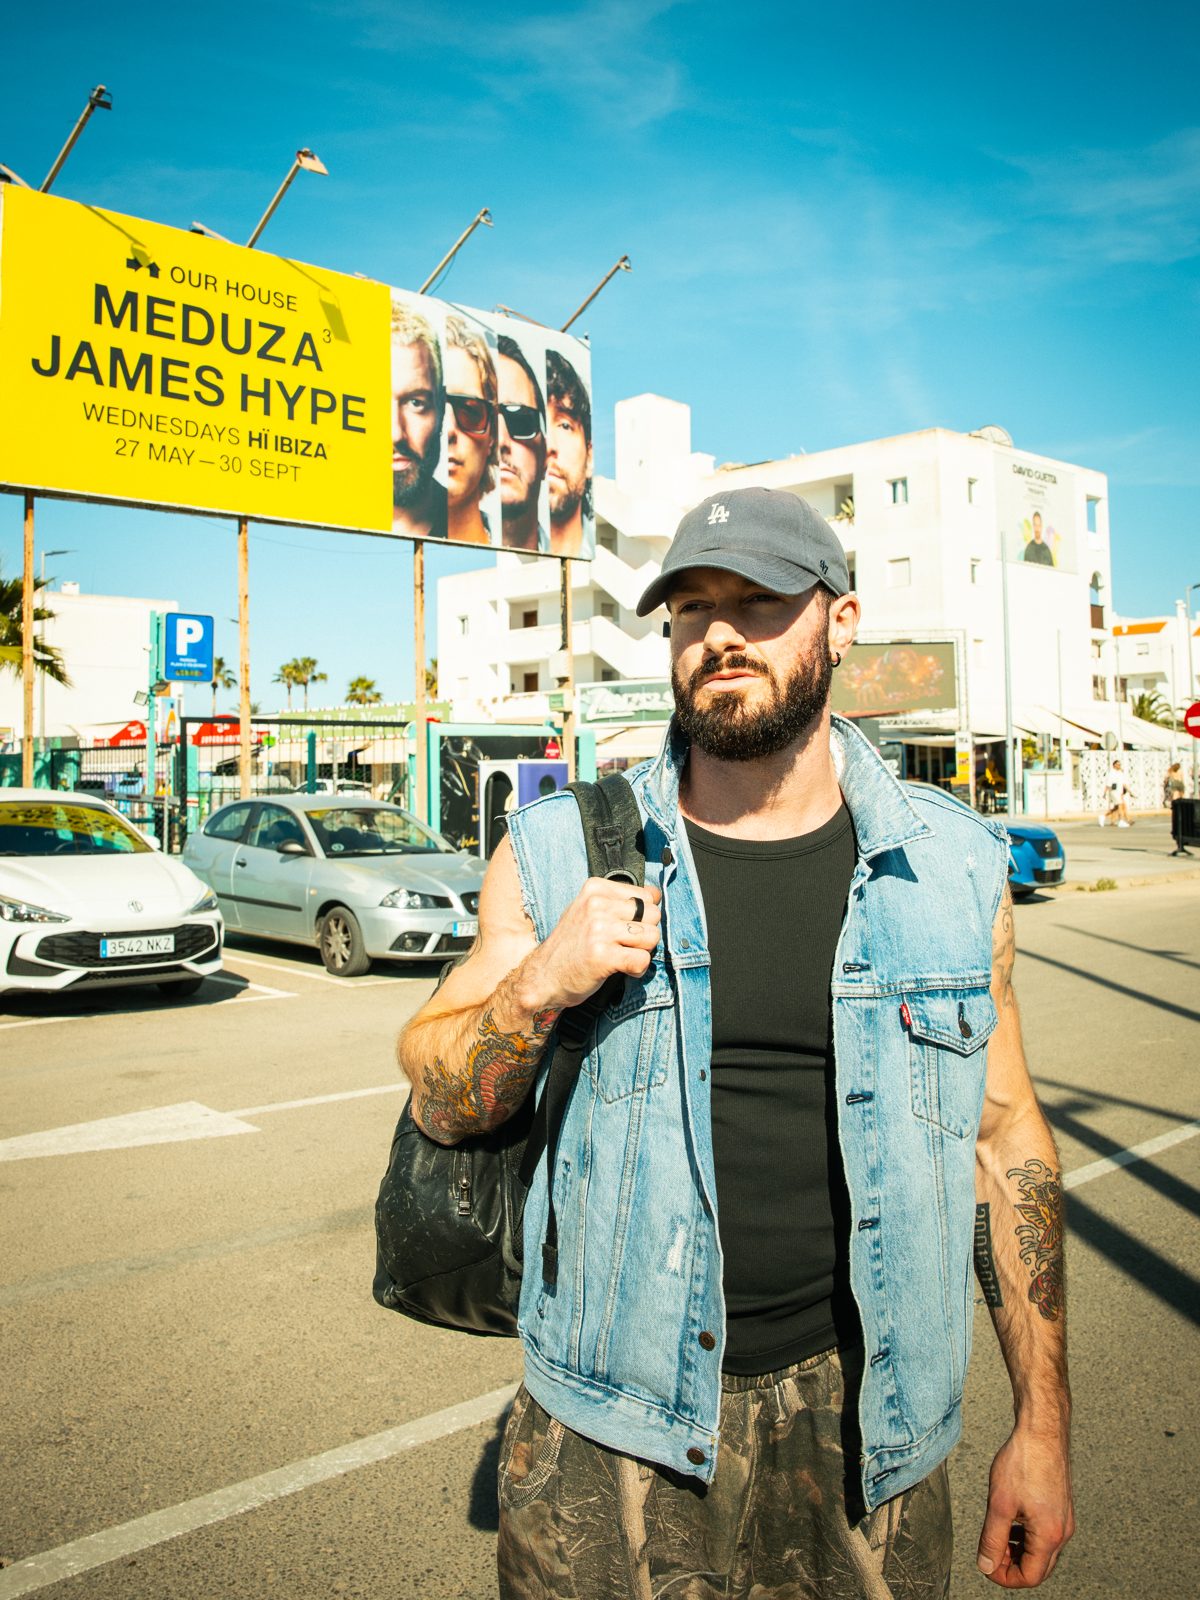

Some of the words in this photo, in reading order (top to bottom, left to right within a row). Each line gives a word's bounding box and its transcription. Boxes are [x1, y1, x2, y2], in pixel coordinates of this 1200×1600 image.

[170, 265, 218, 294] OUR
[225, 278, 298, 313] HOUSE
[31, 334, 225, 408] JAMES
[241, 373, 367, 434] HYPE
[82, 401, 241, 447] WEDNESDAYS
[274, 435, 328, 460] IBIZA
[115, 438, 140, 458] 27
[249, 463, 302, 483] SEPT
[707, 503, 730, 525] LA
[176, 618, 204, 656] P
[110, 939, 143, 955] 3542
[146, 937, 171, 951] NKZ
